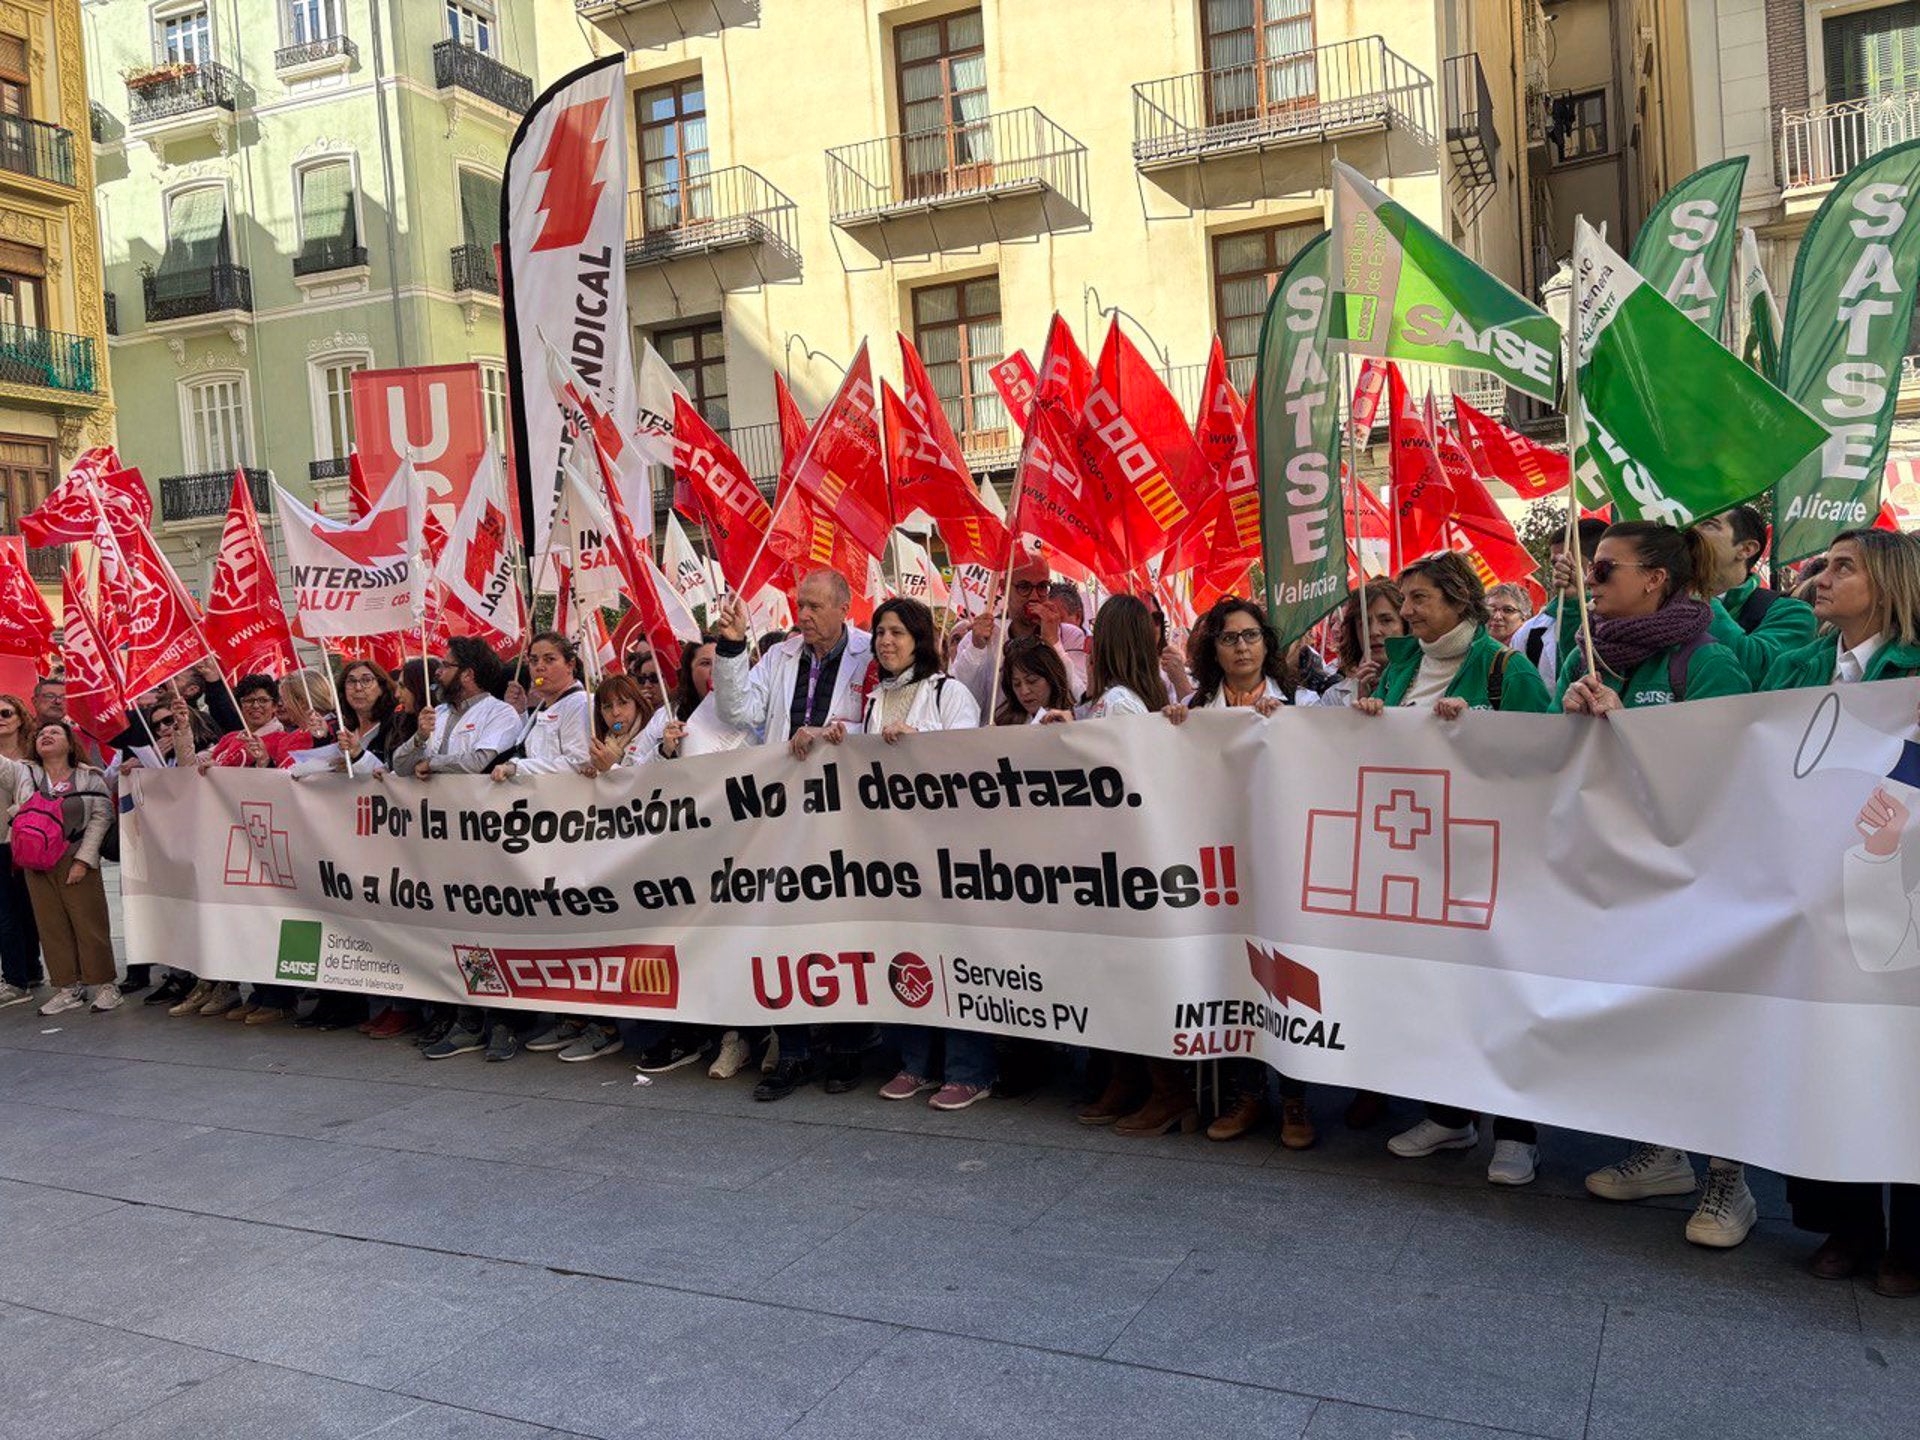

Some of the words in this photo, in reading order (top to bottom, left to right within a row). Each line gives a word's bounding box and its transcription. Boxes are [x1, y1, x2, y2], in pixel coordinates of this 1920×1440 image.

[1665, 200, 1719, 321] SA
[1821, 182, 1908, 481] SATSE
[1284, 276, 1330, 565] SATSE
[1785, 494, 1867, 523] Alicante
[1274, 572, 1337, 607] Valencia
[420, 798, 448, 841] la
[460, 789, 711, 854] negociación.
[725, 775, 787, 821] No
[803, 762, 841, 814] al
[858, 757, 1143, 810] decretazo.
[318, 860, 353, 901] No
[362, 875, 380, 904] a
[390, 867, 434, 912] los
[444, 876, 619, 917] recortes
[633, 874, 696, 909] en
[710, 849, 922, 903] derechos
[937, 845, 1241, 911] laborales!!
[279, 961, 318, 977] SATSE
[325, 955, 340, 969] de
[342, 955, 401, 976] Enfermería
[507, 957, 626, 993] CCOO
[751, 952, 876, 1010] UGT
[953, 958, 1044, 992] Serveis
[958, 994, 1047, 1029] Públics
[1053, 1005, 1089, 1034] PV
[1174, 1000, 1346, 1051] INTERSINDICAL
[1173, 1030, 1256, 1057] SALUT
